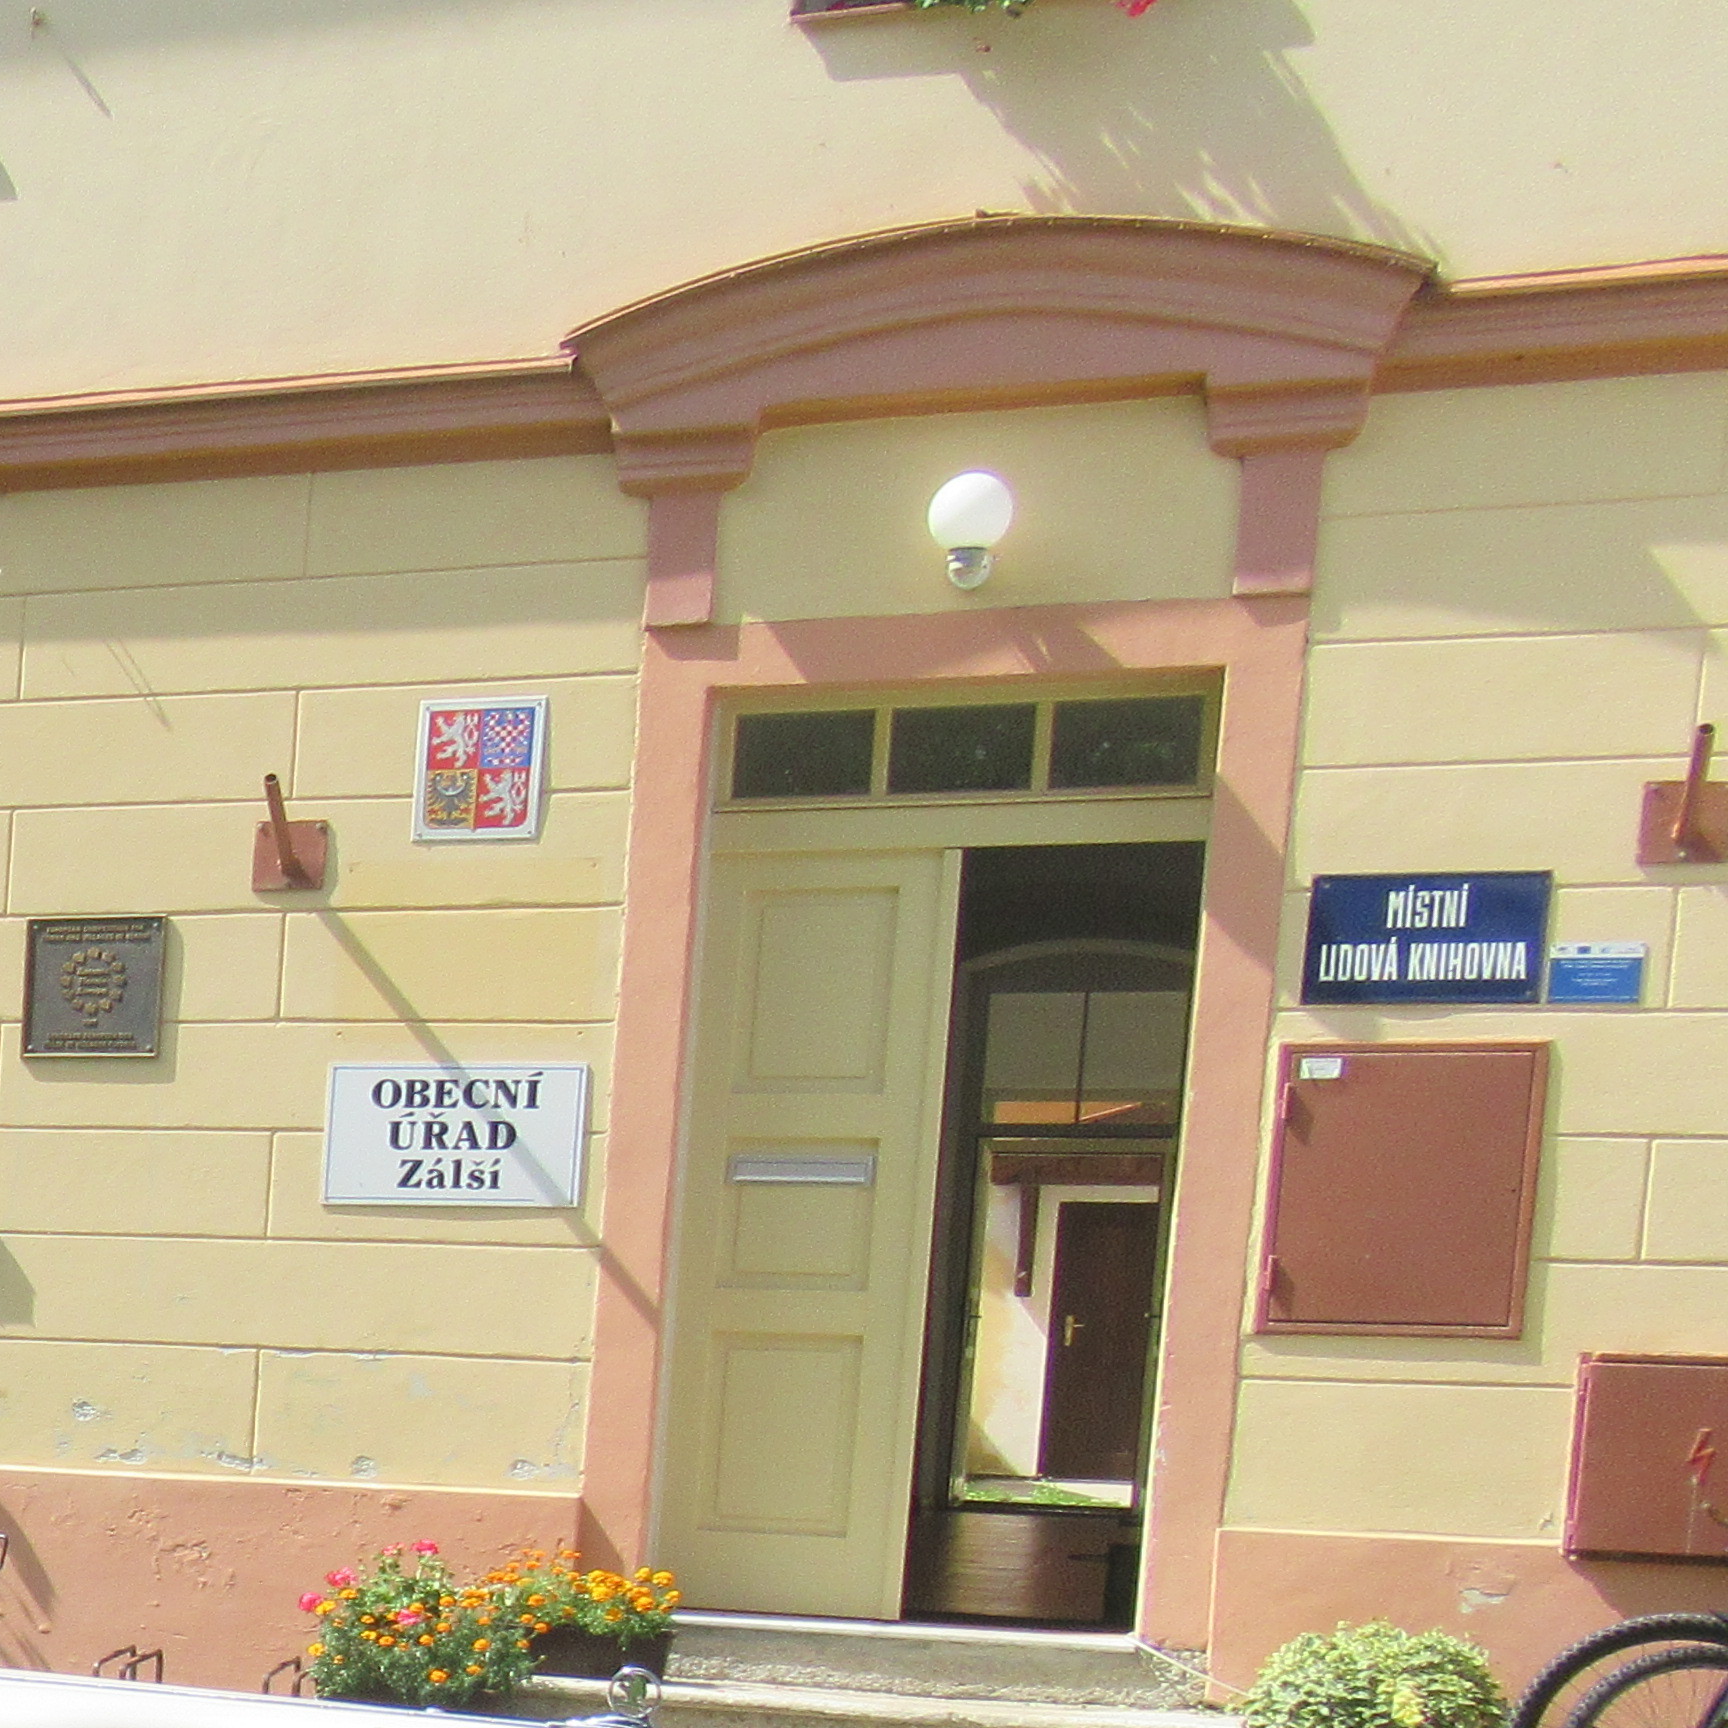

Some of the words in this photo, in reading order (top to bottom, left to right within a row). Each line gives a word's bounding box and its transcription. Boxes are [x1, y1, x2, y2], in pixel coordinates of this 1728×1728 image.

[1386, 883, 1470, 929] MÍSTNÍ
[1318, 936, 1399, 982] LIDOVÁ
[1407, 941, 1528, 981] KNIHOVNA
[371, 1071, 544, 1110] OBECNÍ
[388, 1112, 517, 1151] ÚŘAD
[397, 1157, 502, 1190] Zálší
